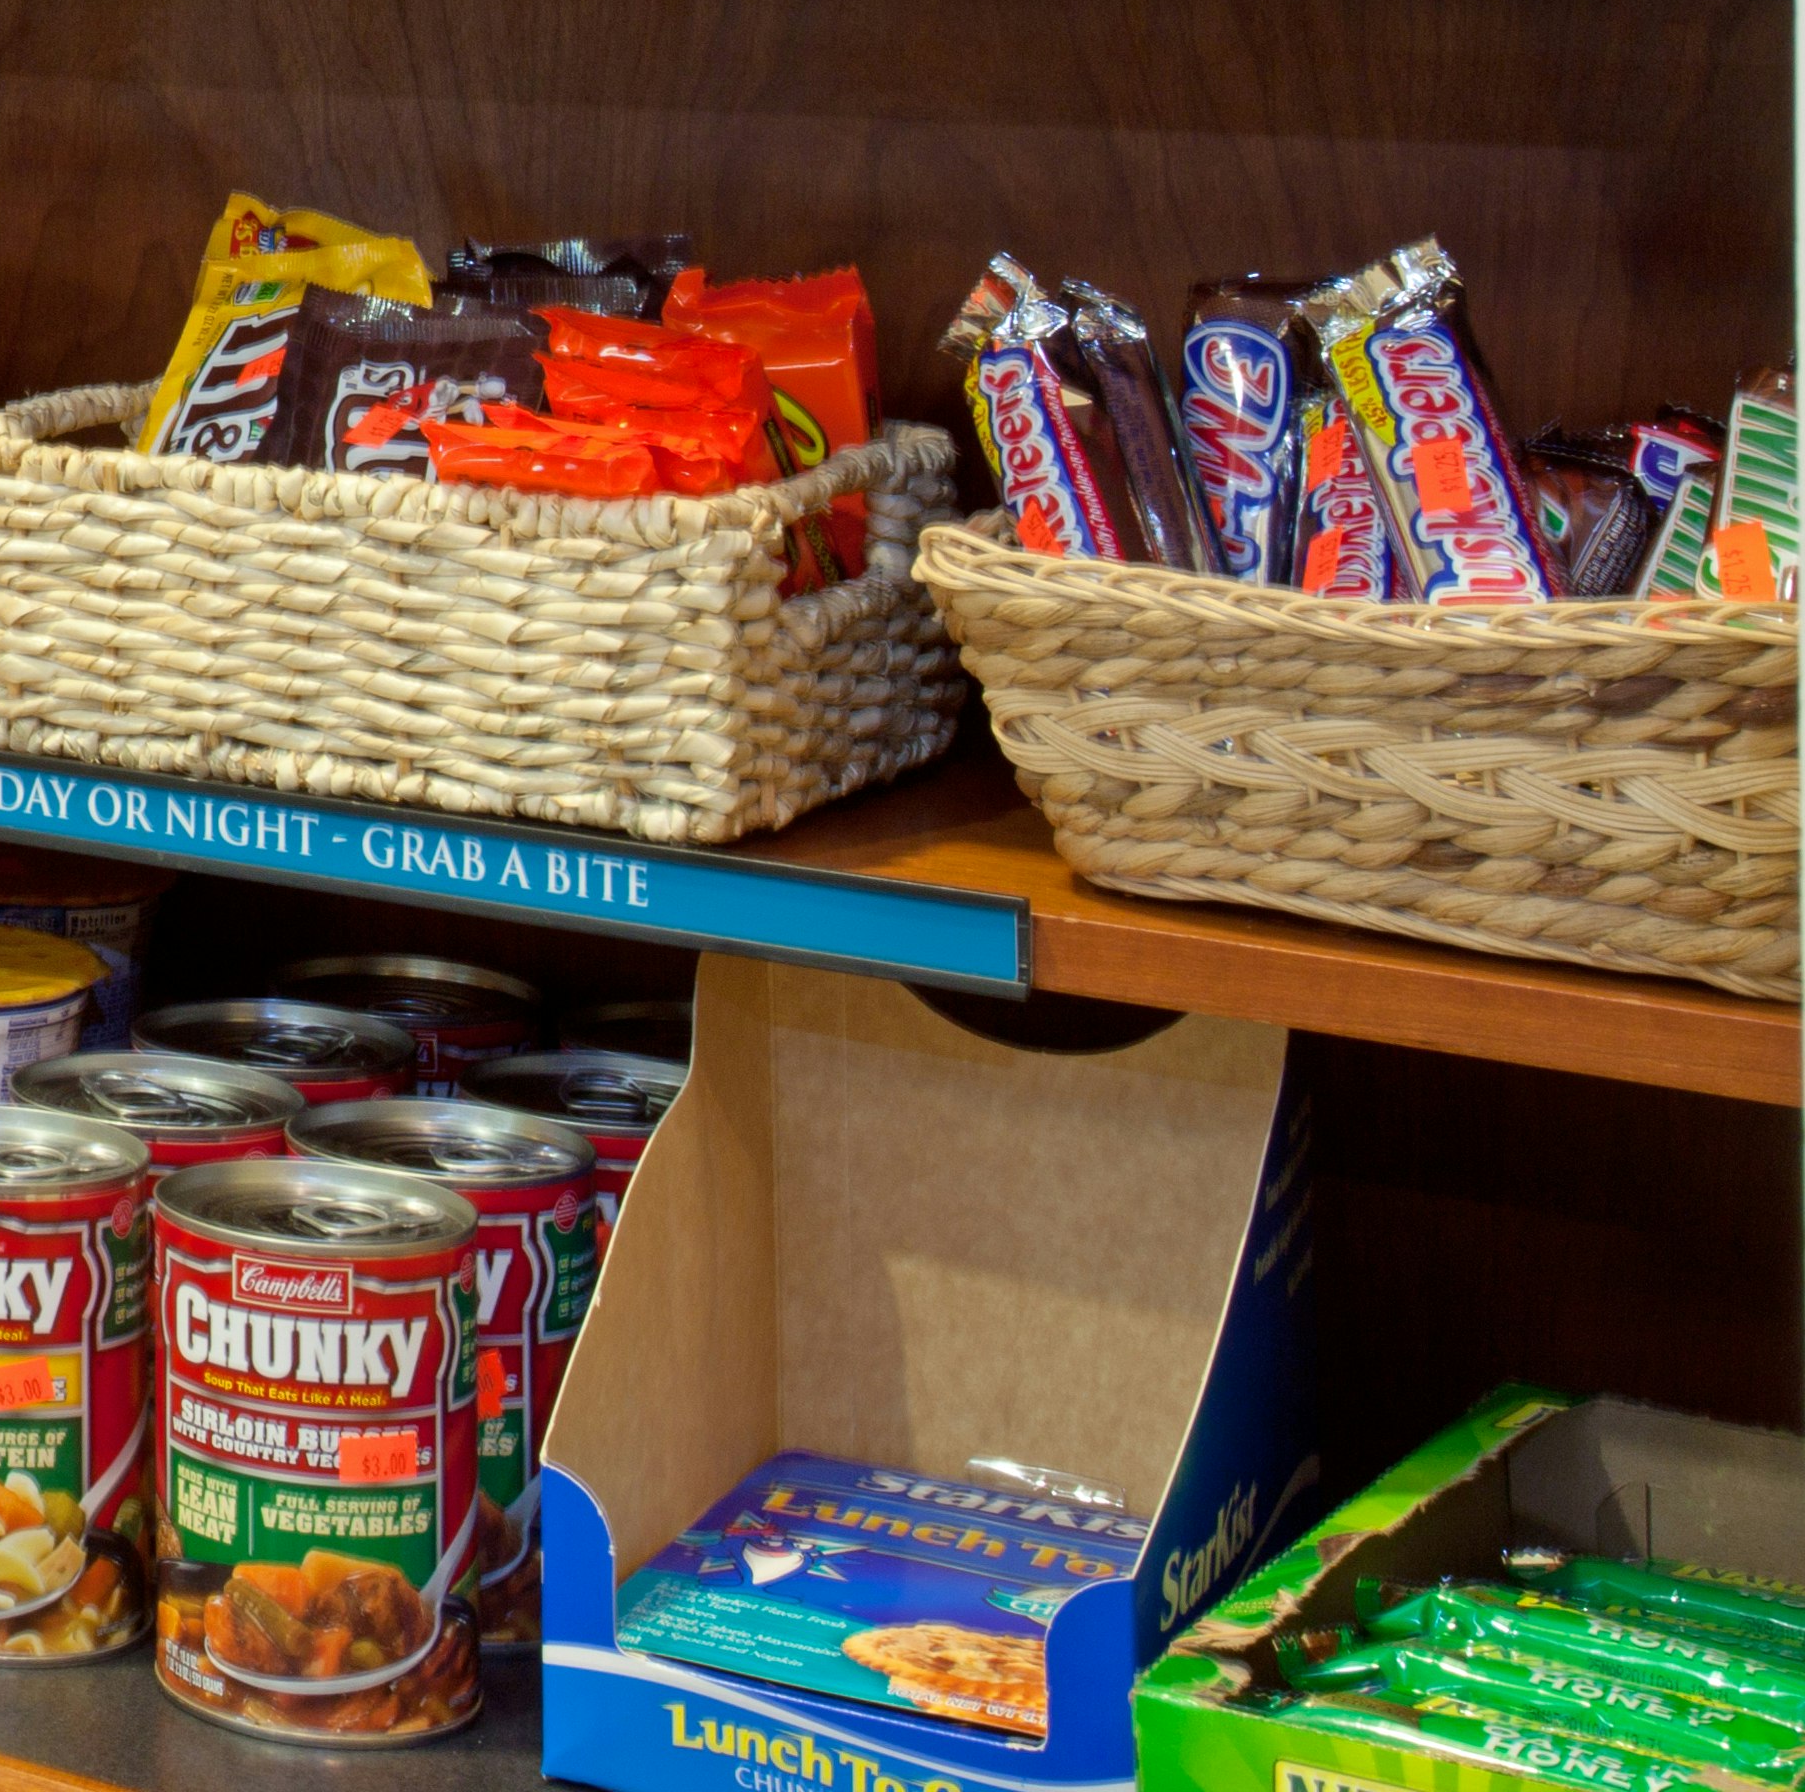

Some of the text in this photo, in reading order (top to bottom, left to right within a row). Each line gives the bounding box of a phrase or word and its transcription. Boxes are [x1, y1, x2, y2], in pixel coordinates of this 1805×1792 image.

[1434, 445, 1458, 494] $1.25
[87, 783, 153, 834] OR
[166, 793, 320, 859] NIGHT
[361, 825, 488, 883] GRAB
[497, 846, 532, 891] A
[545, 849, 651, 909] BITE
[239, 1260, 344, 1305] Campbell's
[175, 1283, 429, 1399] CHUNKY
[43, 1430, 68, 1448] OF
[180, 1398, 289, 1444] SIRLOIN
[362, 1452, 408, 1478] $3.00
[177, 1480, 238, 1511] LEAN
[274, 1494, 421, 1515] FULL SERVING OF
[177, 1510, 238, 1545] MEAT
[260, 1510, 432, 1537] VEGETABLES
[1159, 1480, 1258, 1632] StarKist
[1588, 1617, 1767, 1675] HONEY
[663, 1701, 832, 1781] Lunch
[1484, 1735, 1674, 1792] HONEY
